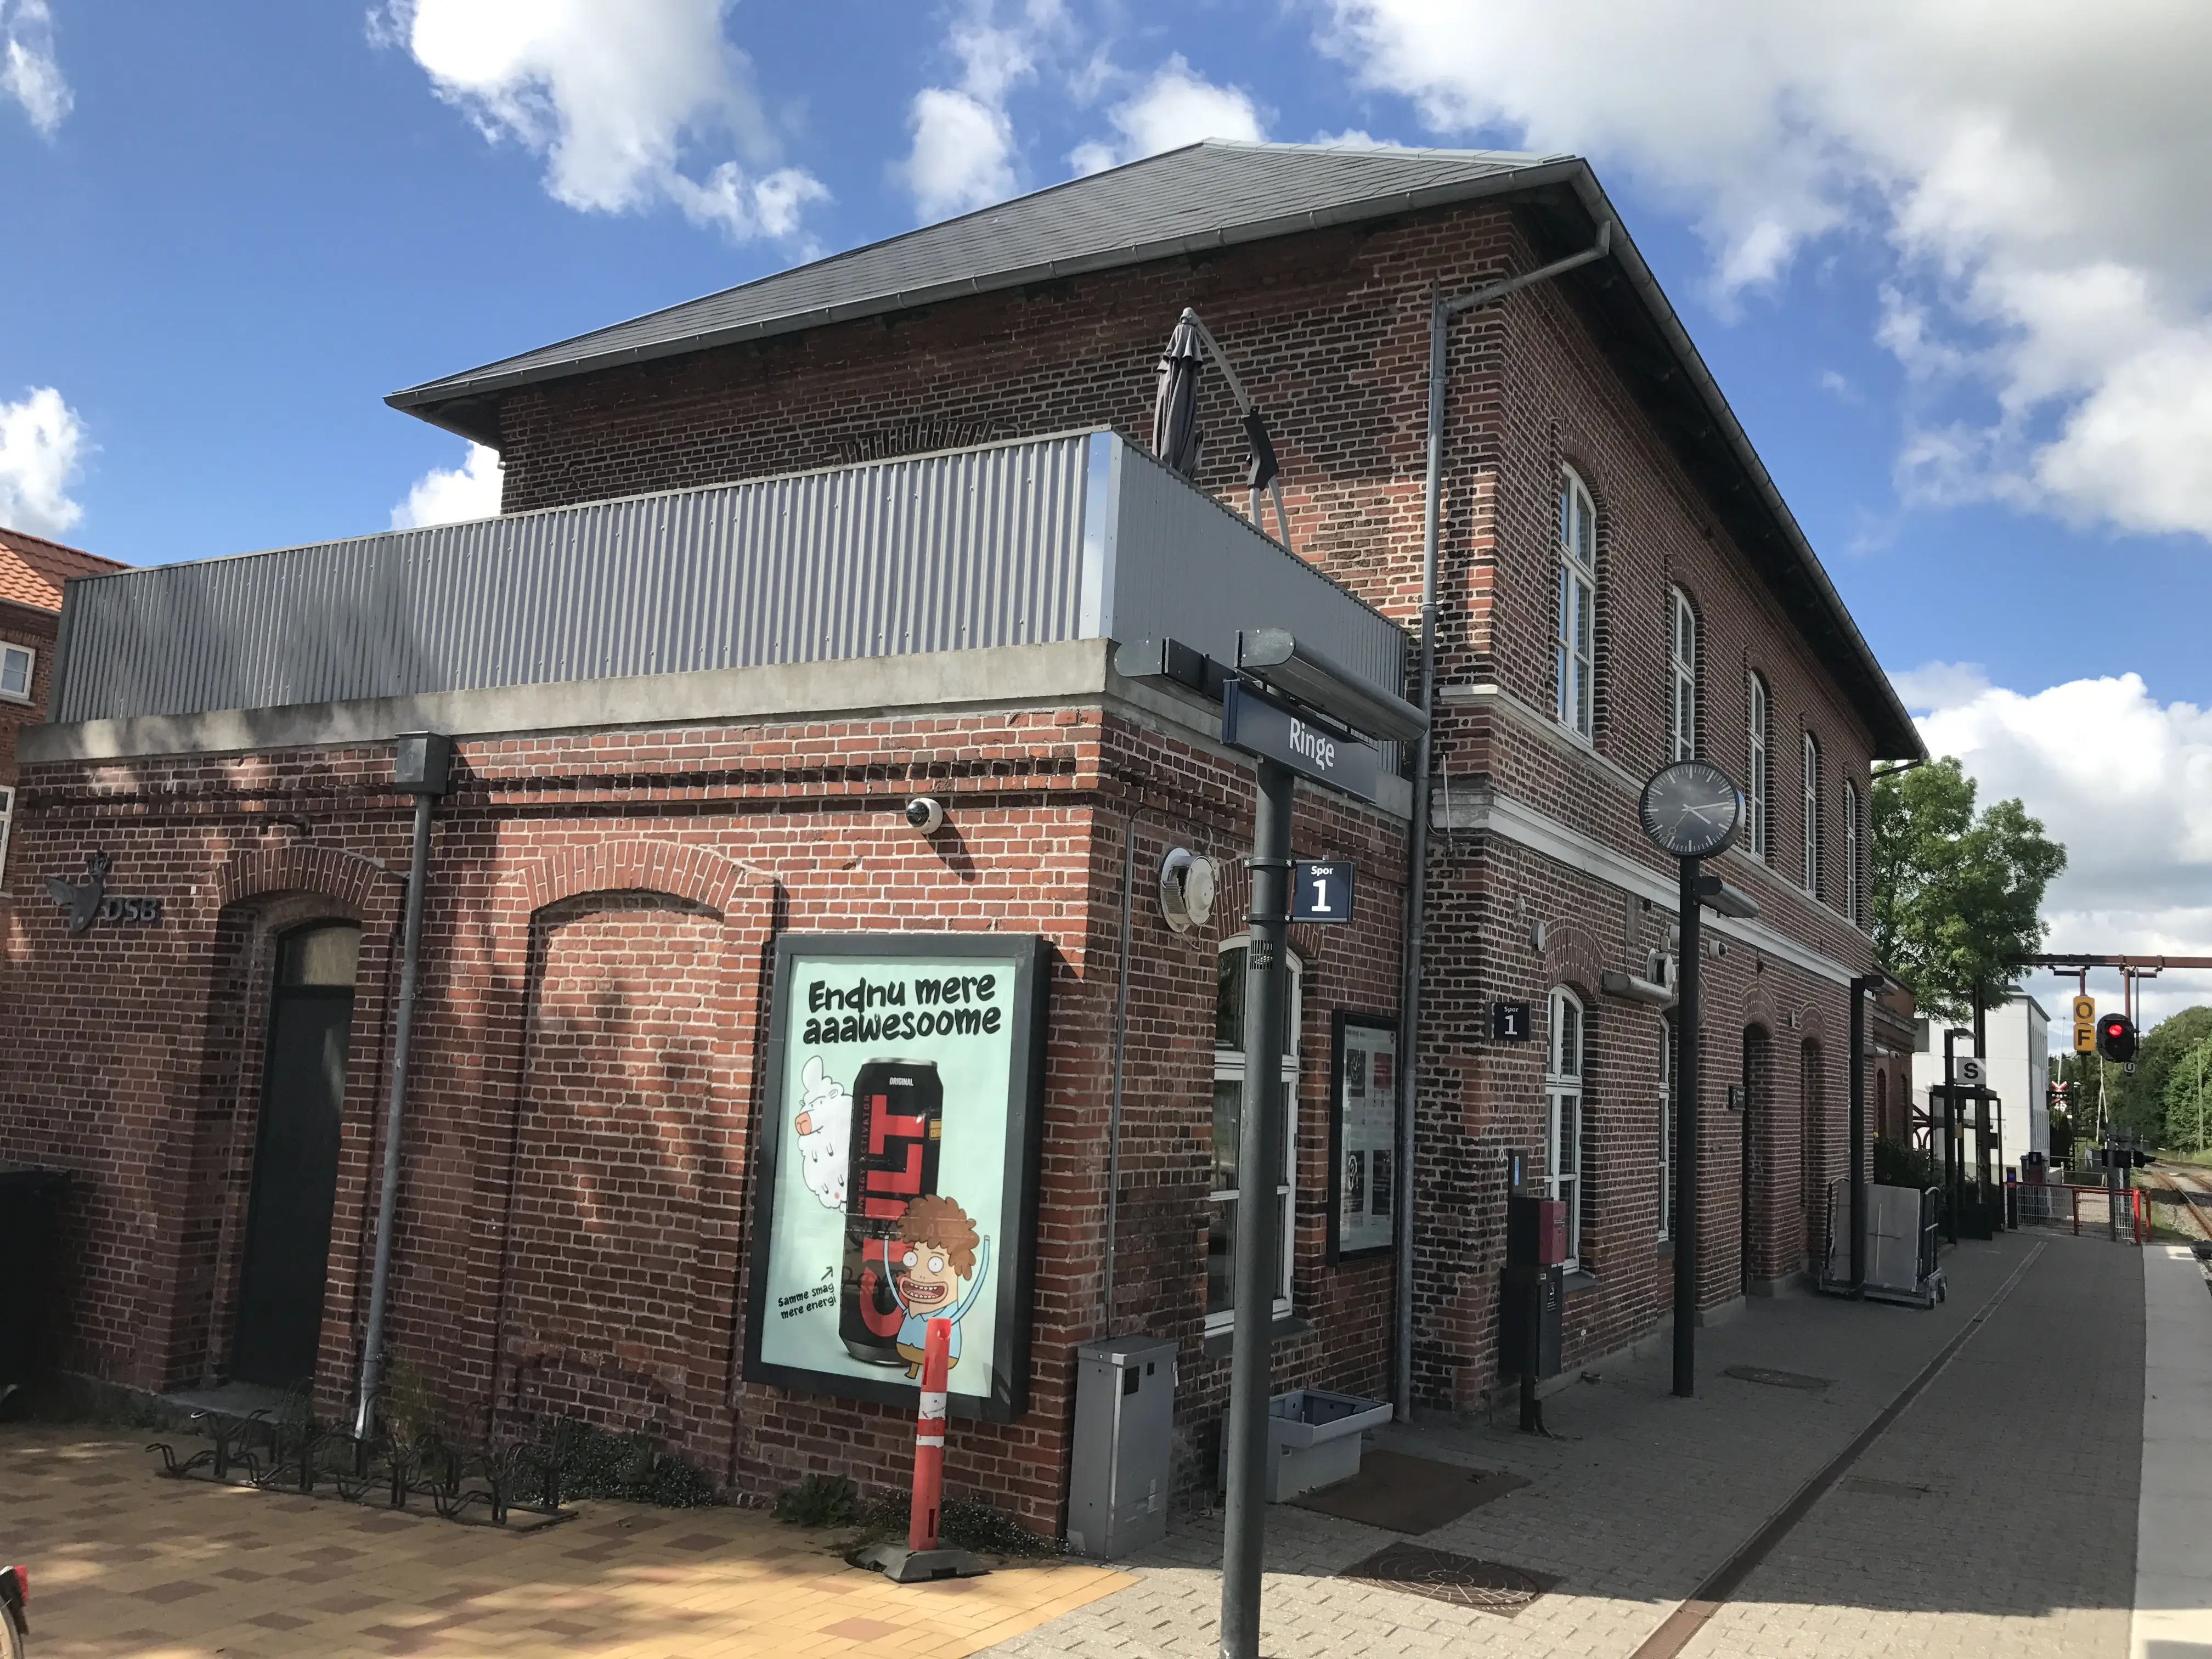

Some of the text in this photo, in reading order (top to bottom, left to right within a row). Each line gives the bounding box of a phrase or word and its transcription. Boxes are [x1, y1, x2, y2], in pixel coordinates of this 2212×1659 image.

[1289, 717, 1335, 770] Ringe
[1311, 866, 1334, 876] Spor
[1311, 879, 1331, 912] 1
[103, 898, 157, 921] DSB
[809, 974, 996, 1013] Endnu mere
[2075, 1002, 2092, 1019] O
[803, 1007, 1001, 1044] aaawesoome
[1504, 1015, 1517, 1035] 1
[2078, 1029, 2091, 1046] F
[1963, 1062, 1978, 1079] S
[2126, 1063, 2134, 1072] U
[889, 1077, 914, 1086] ORIGINAL
[859, 1094, 871, 1162] ACTIVATOR
[778, 1283, 834, 1307] Samme smag
[781, 1294, 837, 1319] mere energi
